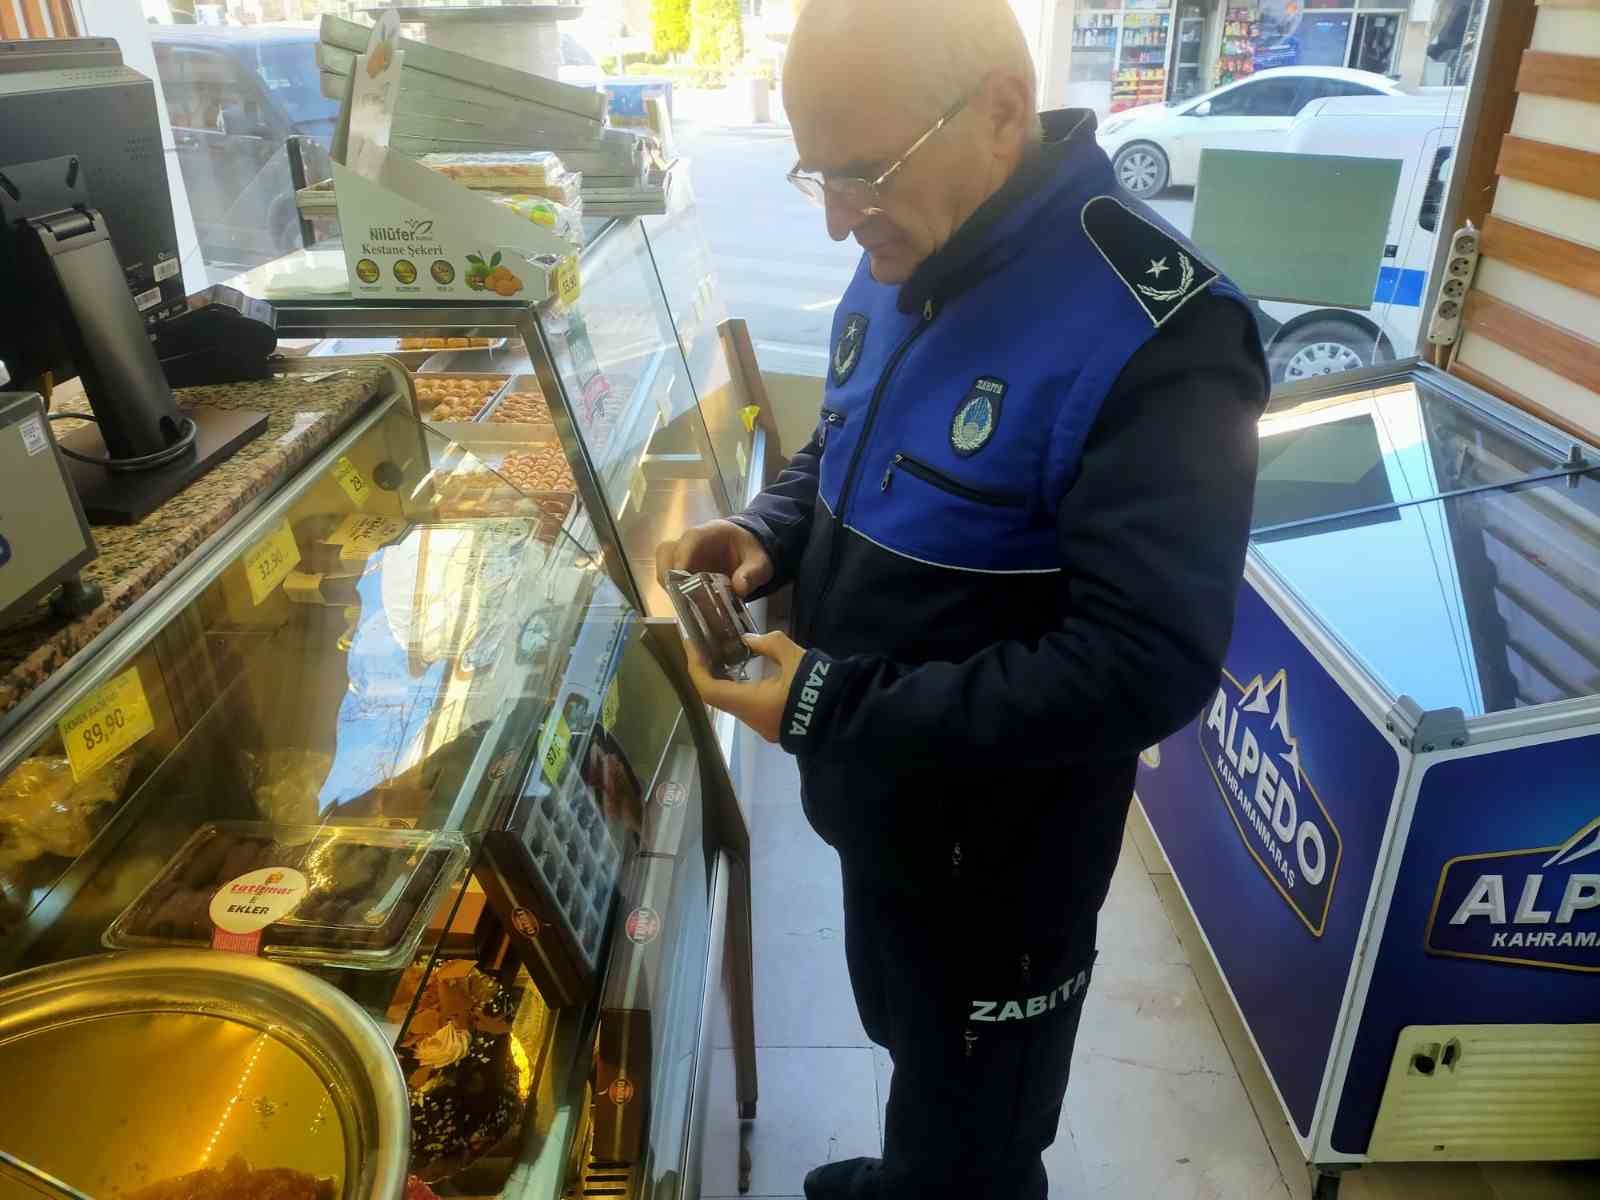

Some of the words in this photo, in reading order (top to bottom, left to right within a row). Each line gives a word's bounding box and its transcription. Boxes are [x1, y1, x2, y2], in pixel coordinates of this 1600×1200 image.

[362, 243, 405, 256] Kestane
[407, 243, 443, 257] Şekeri
[788, 660, 831, 736] ZABITA
[82, 708, 125, 751] 89,90
[1206, 687, 1326, 886] ALPEDO
[226, 904, 271, 915] EKLER
[1490, 931, 1600, 948] KAHRAM
[968, 969, 1087, 1022] ZABITA
